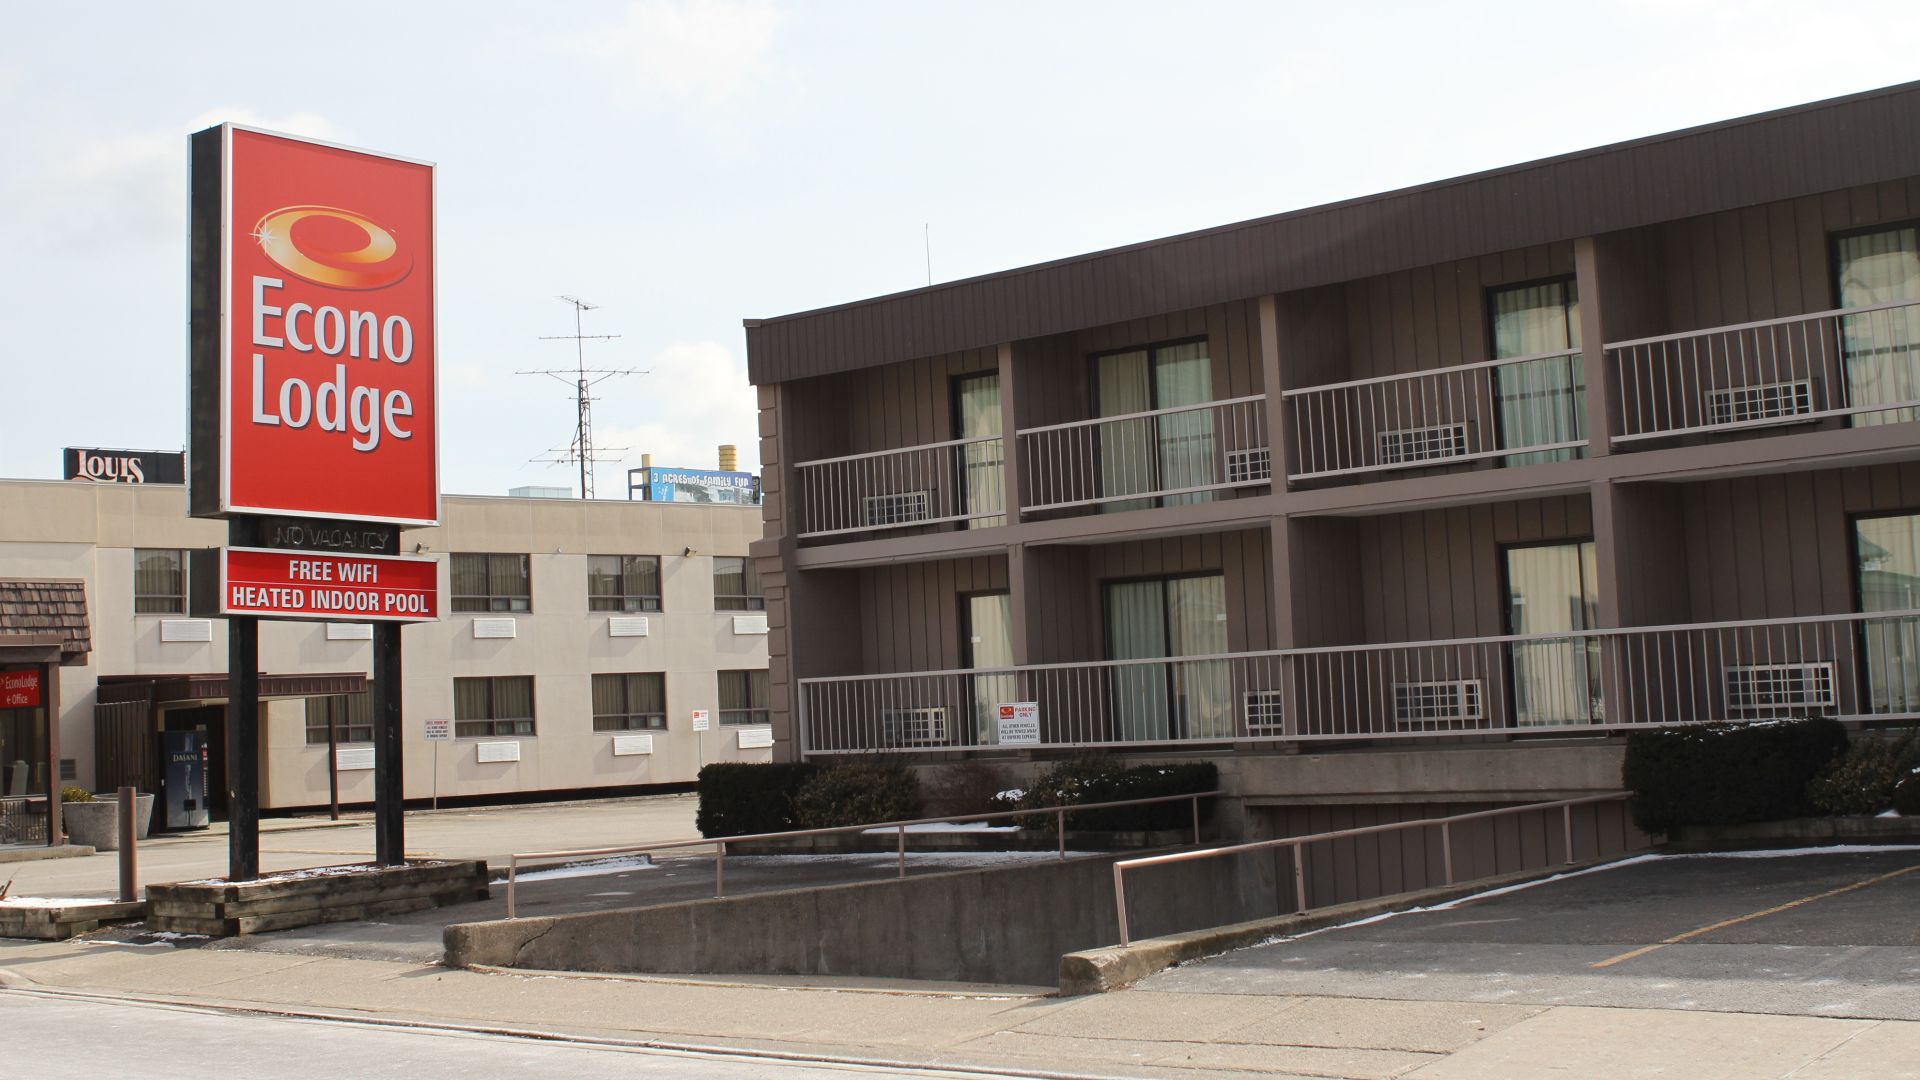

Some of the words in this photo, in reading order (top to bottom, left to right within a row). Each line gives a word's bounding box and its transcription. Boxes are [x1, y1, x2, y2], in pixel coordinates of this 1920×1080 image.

[252, 275, 413, 364] Econo
[252, 353, 413, 451] Lodge
[653, 473, 659, 483] 3
[662, 473, 688, 484] ACRES
[276, 526, 304, 545] NO
[309, 529, 389, 549] VACANCY
[289, 560, 333, 581] FREE
[337, 562, 378, 584] WIFI
[232, 586, 305, 609] HEATED
[311, 590, 379, 612] INDOOR
[385, 594, 429, 613] POOL
[11, 693, 28, 704] Office
[173, 753, 198, 762] DASANI
